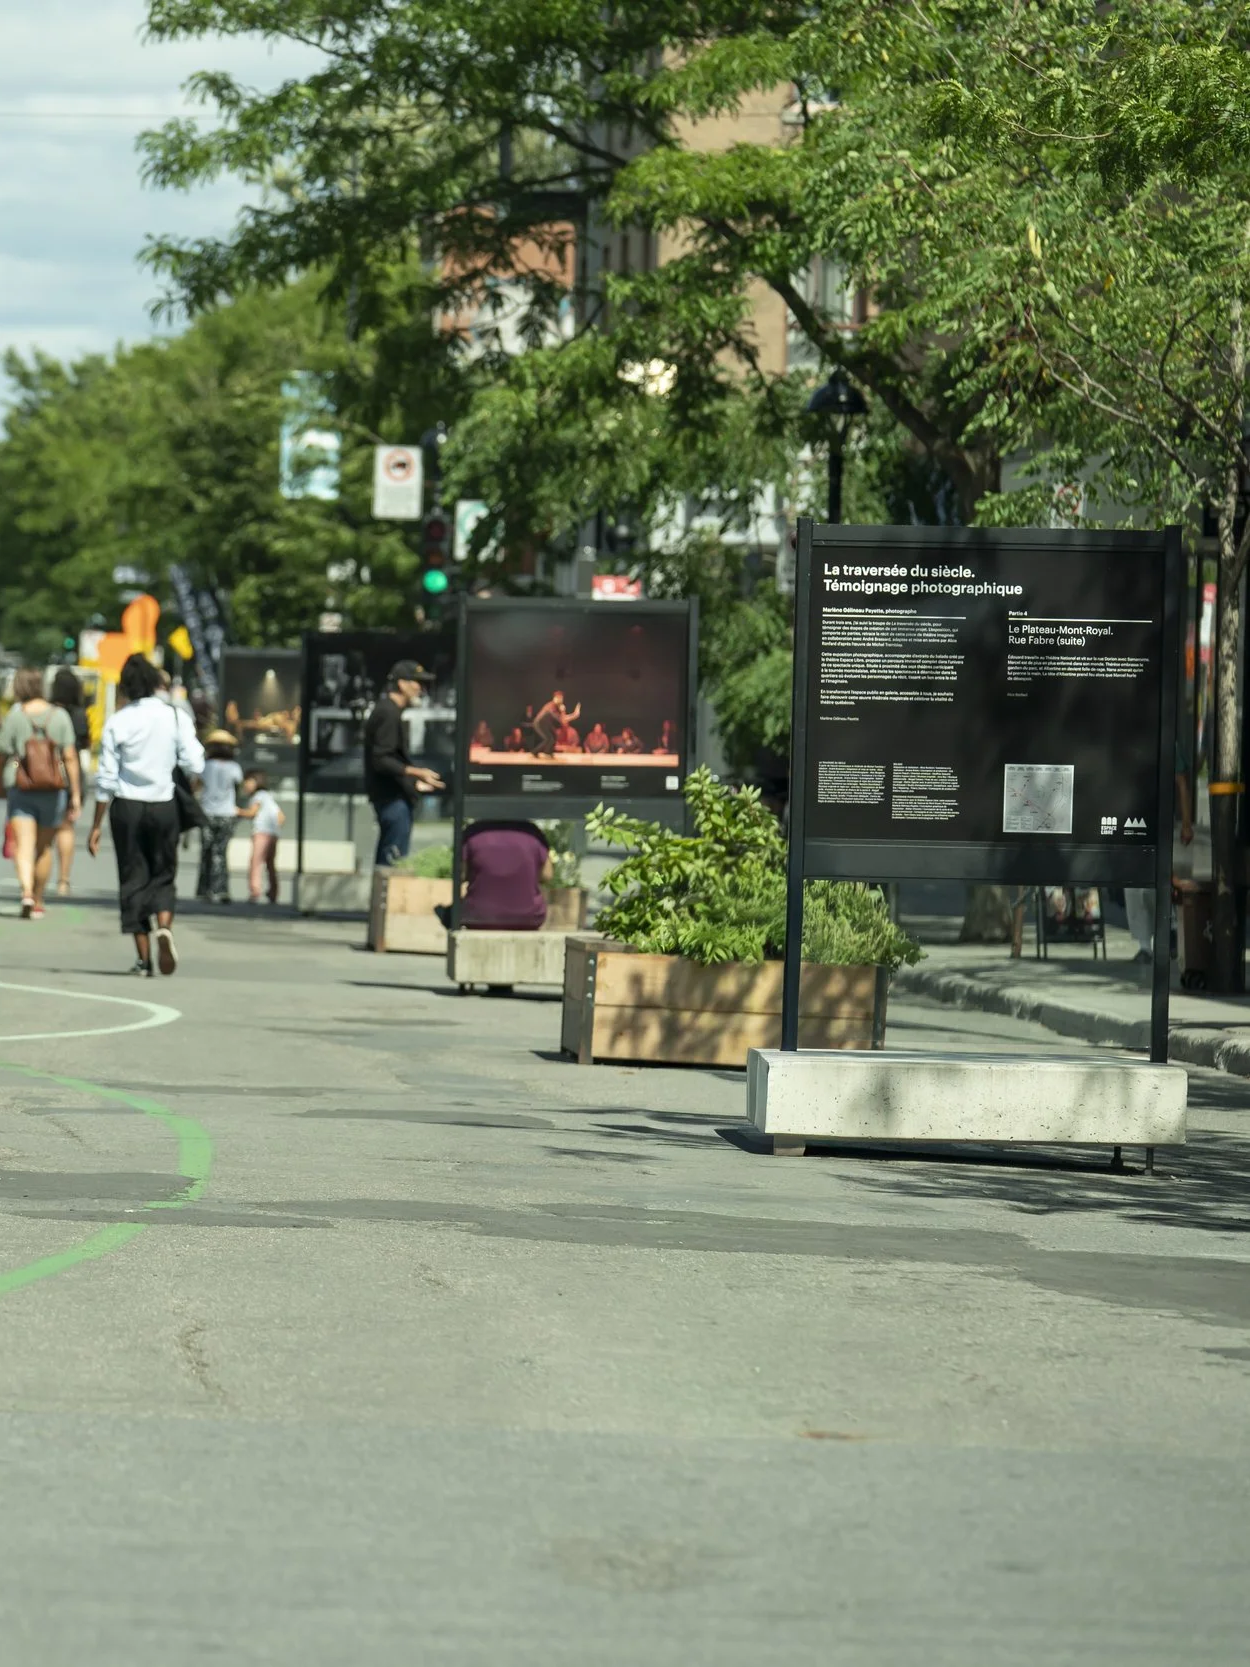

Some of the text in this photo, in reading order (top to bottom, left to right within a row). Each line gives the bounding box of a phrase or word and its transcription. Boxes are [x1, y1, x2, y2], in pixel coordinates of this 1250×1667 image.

[824, 563, 975, 578] La traversée du siècle.
[824, 579, 1023, 597] Témoignage photographique
[1009, 625, 1113, 637] Le Plateau-Mont-Royal.
[1009, 636, 1086, 647] Rue Fabre (suite)
